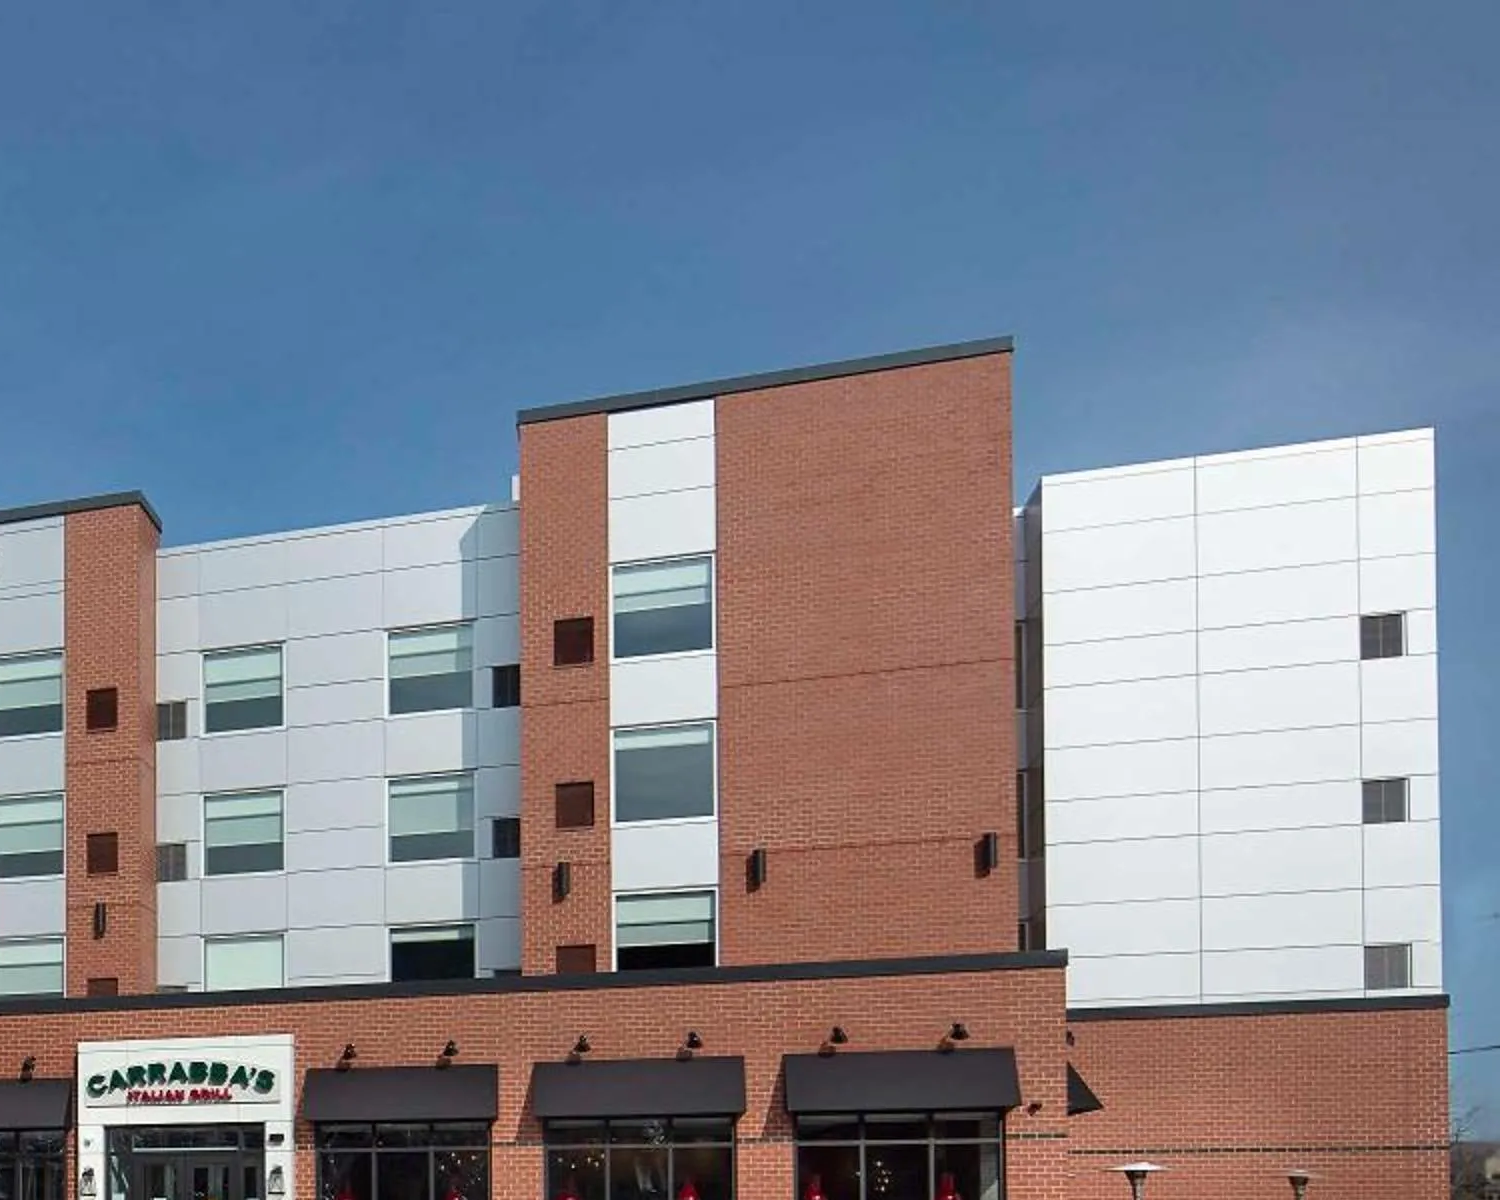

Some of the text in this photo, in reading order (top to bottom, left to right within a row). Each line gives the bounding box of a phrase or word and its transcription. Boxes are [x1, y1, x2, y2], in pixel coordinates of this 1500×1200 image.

[86, 1061, 275, 1098] CARRABBA'S
[126, 1088, 232, 1103] ITALIAN GRILL
